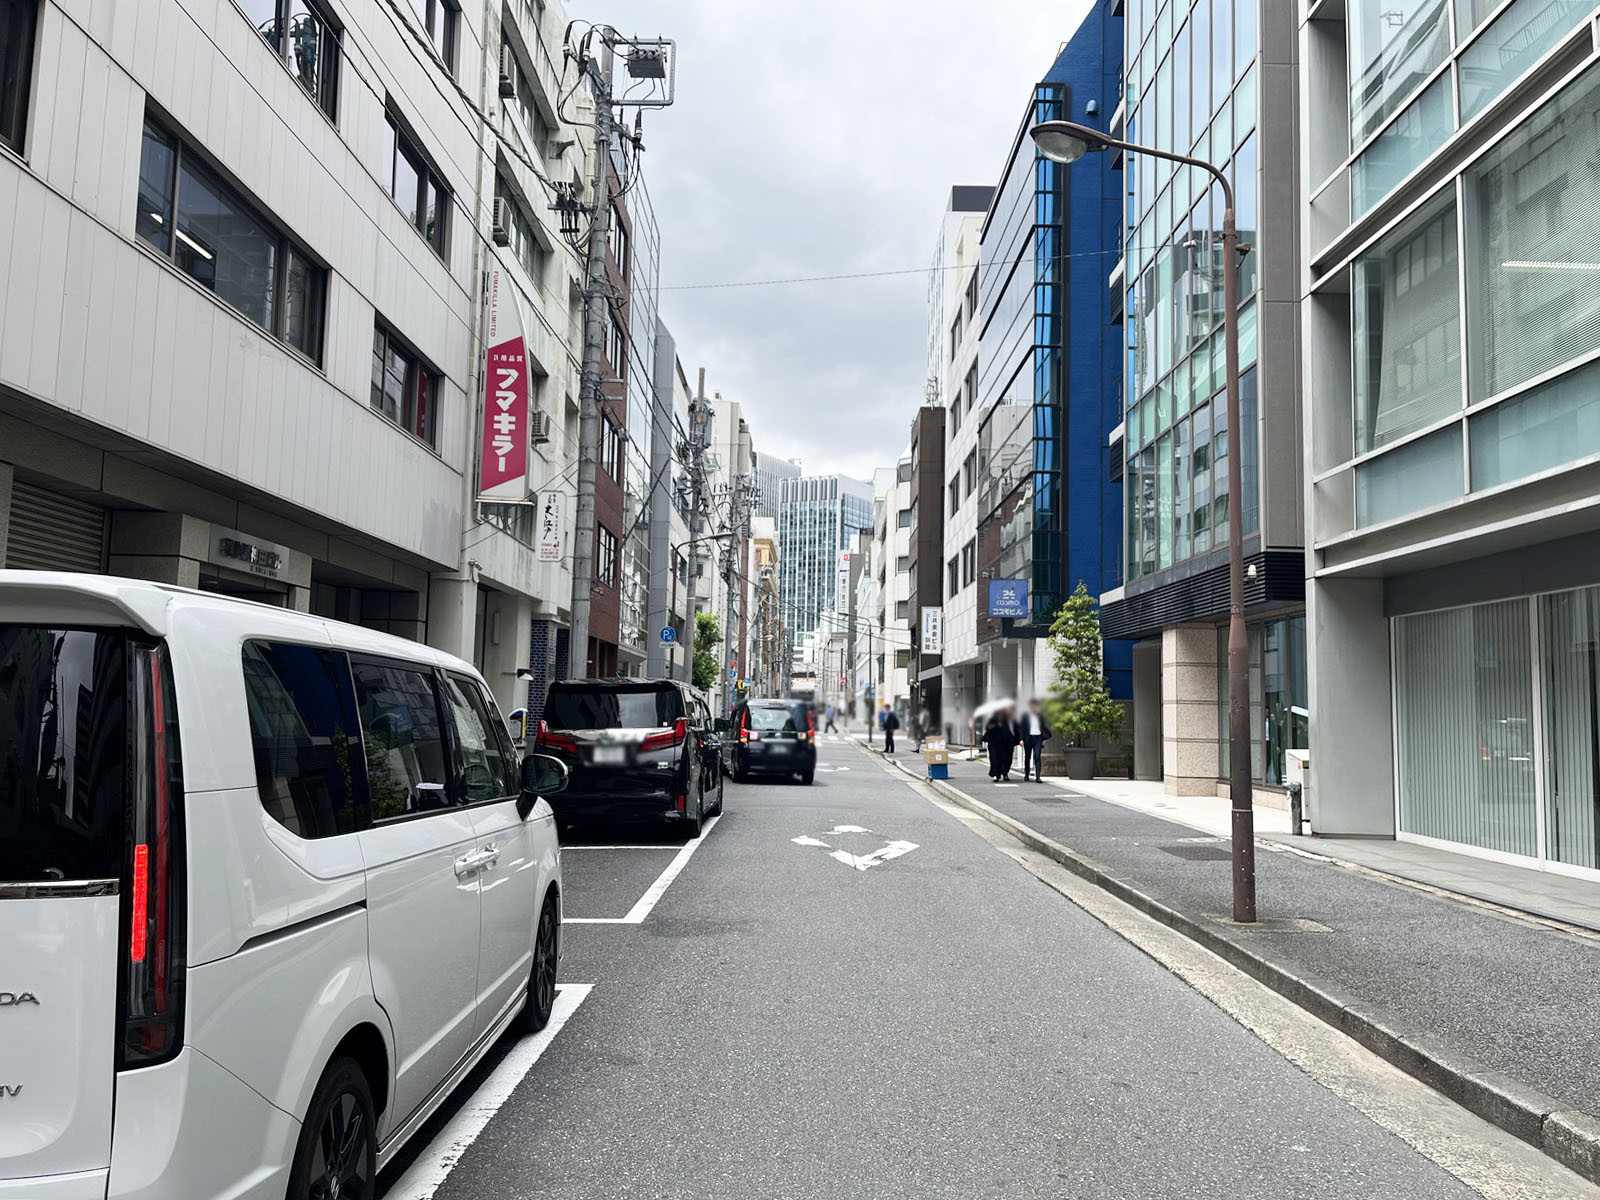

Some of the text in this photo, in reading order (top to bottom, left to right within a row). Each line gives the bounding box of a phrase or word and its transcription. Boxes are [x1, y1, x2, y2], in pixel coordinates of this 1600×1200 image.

[491, 368, 519, 473] フマキラー
[992, 608, 1024, 616] コスモビル
[663, 629, 670, 640] P
